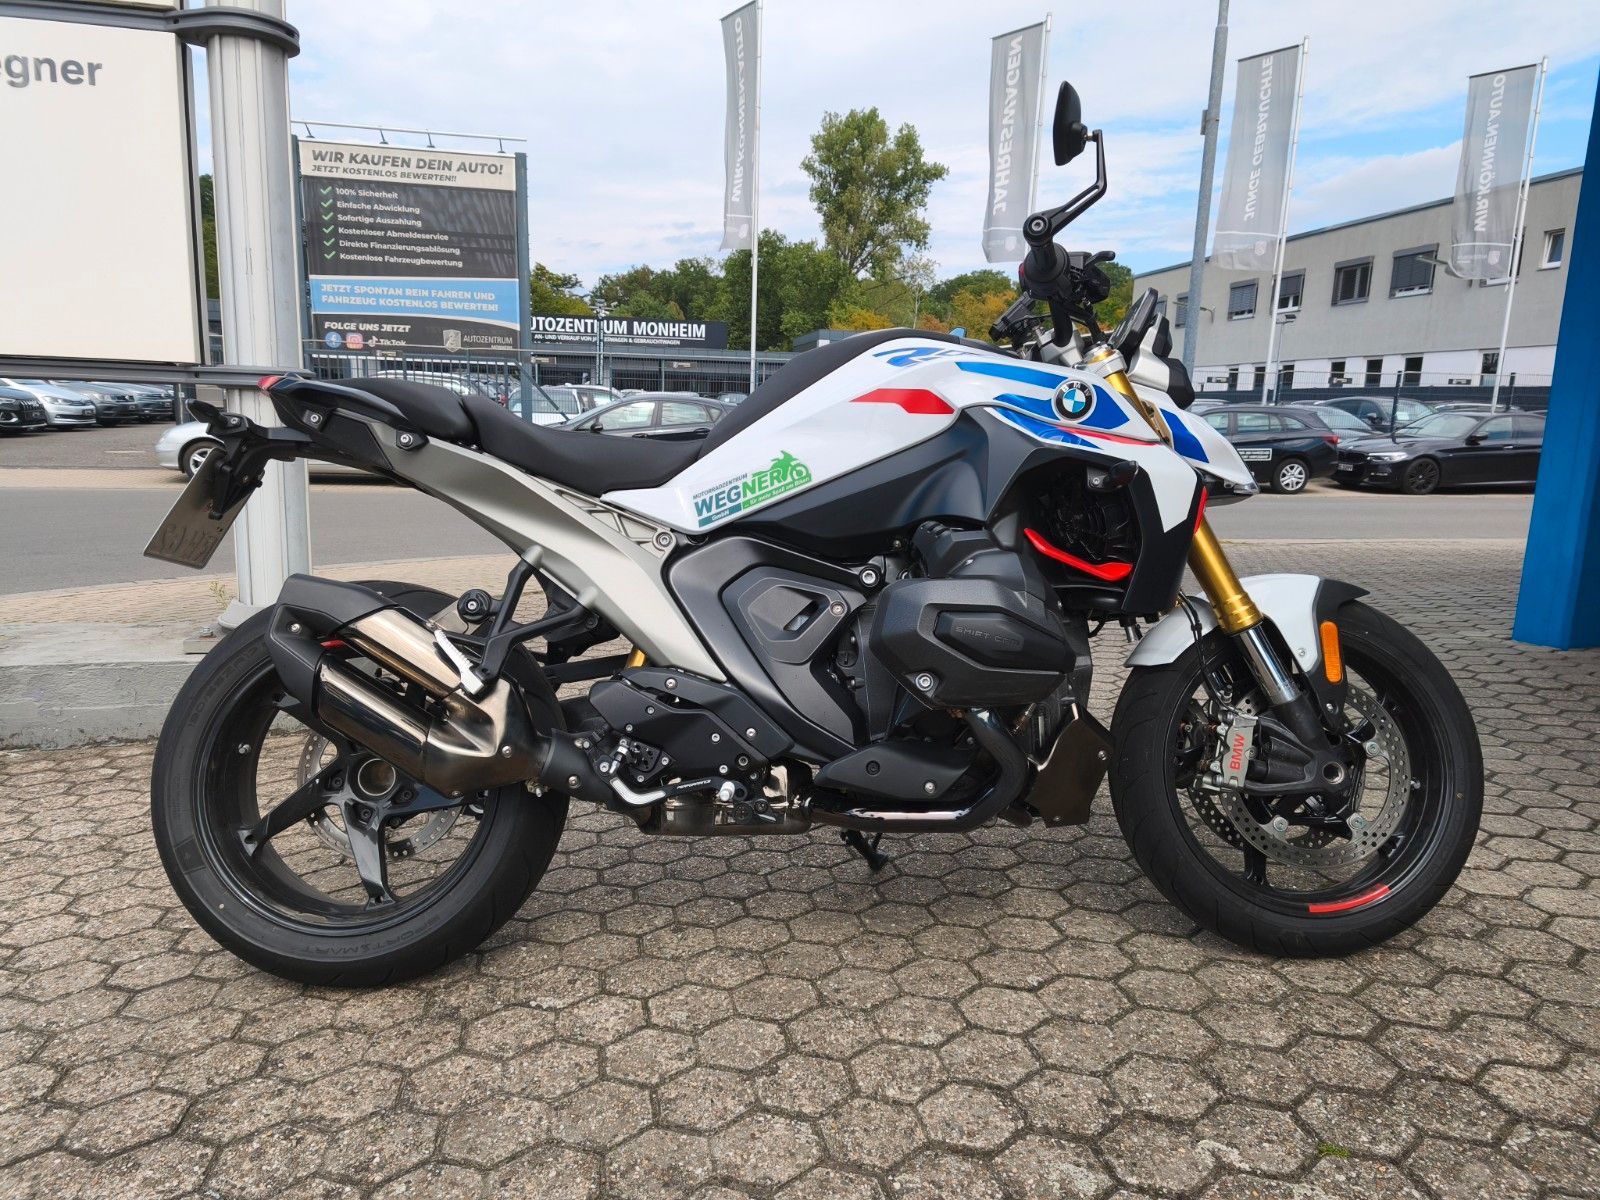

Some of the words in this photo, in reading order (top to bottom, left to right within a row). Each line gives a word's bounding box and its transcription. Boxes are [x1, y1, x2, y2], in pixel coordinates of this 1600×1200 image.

[0, 54, 103, 88] gner
[312, 150, 344, 163] WIR
[349, 152, 412, 168] KAUFEN
[416, 158, 453, 172] DEIN
[456, 162, 504, 176] AUTO!
[312, 164, 340, 174] JETZT
[342, 167, 398, 178] KOSTENLOS
[400, 172, 457, 182] BEWERTEN!!
[336, 188, 356, 196] 100%
[358, 190, 398, 199] Sicherheit
[337, 201, 371, 210] Einfache
[373, 204, 420, 214] Abwicklung
[337, 214, 374, 224] Sofortige
[376, 217, 422, 227] Auszahlung
[338, 227, 385, 236] Kostenloser
[386, 230, 449, 241] Abmeldeservice
[339, 240, 368, 248] Direkte
[370, 242, 460, 255] Finanzierungsablösung
[340, 253, 383, 262] Kostenlose
[384, 255, 463, 268] Fahrzeugbewertung
[321, 284, 351, 293] JETZT
[354, 286, 403, 296] SPONTAN
[406, 288, 429, 297] REIN
[431, 289, 472, 300] FAHREN
[474, 292, 496, 300] UND
[321, 295, 376, 306] FAHRZEUG
[379, 298, 438, 309] KOSTENLOS
[440, 301, 498, 312] BEWERTEN!
[324, 322, 357, 331] FOLGE
[358, 323, 380, 332] UNS
[381, 324, 411, 333] JETZT
[530, 316, 628, 335] UTOZENTUM
[633, 320, 706, 338] MONHEIM
[463, 335, 513, 345] AUTOZENTRUM
[692, 473, 748, 500] MOTORRADZENTRUM
[694, 468, 783, 518] WEGNER
[1230, 734, 1245, 770] BMW
